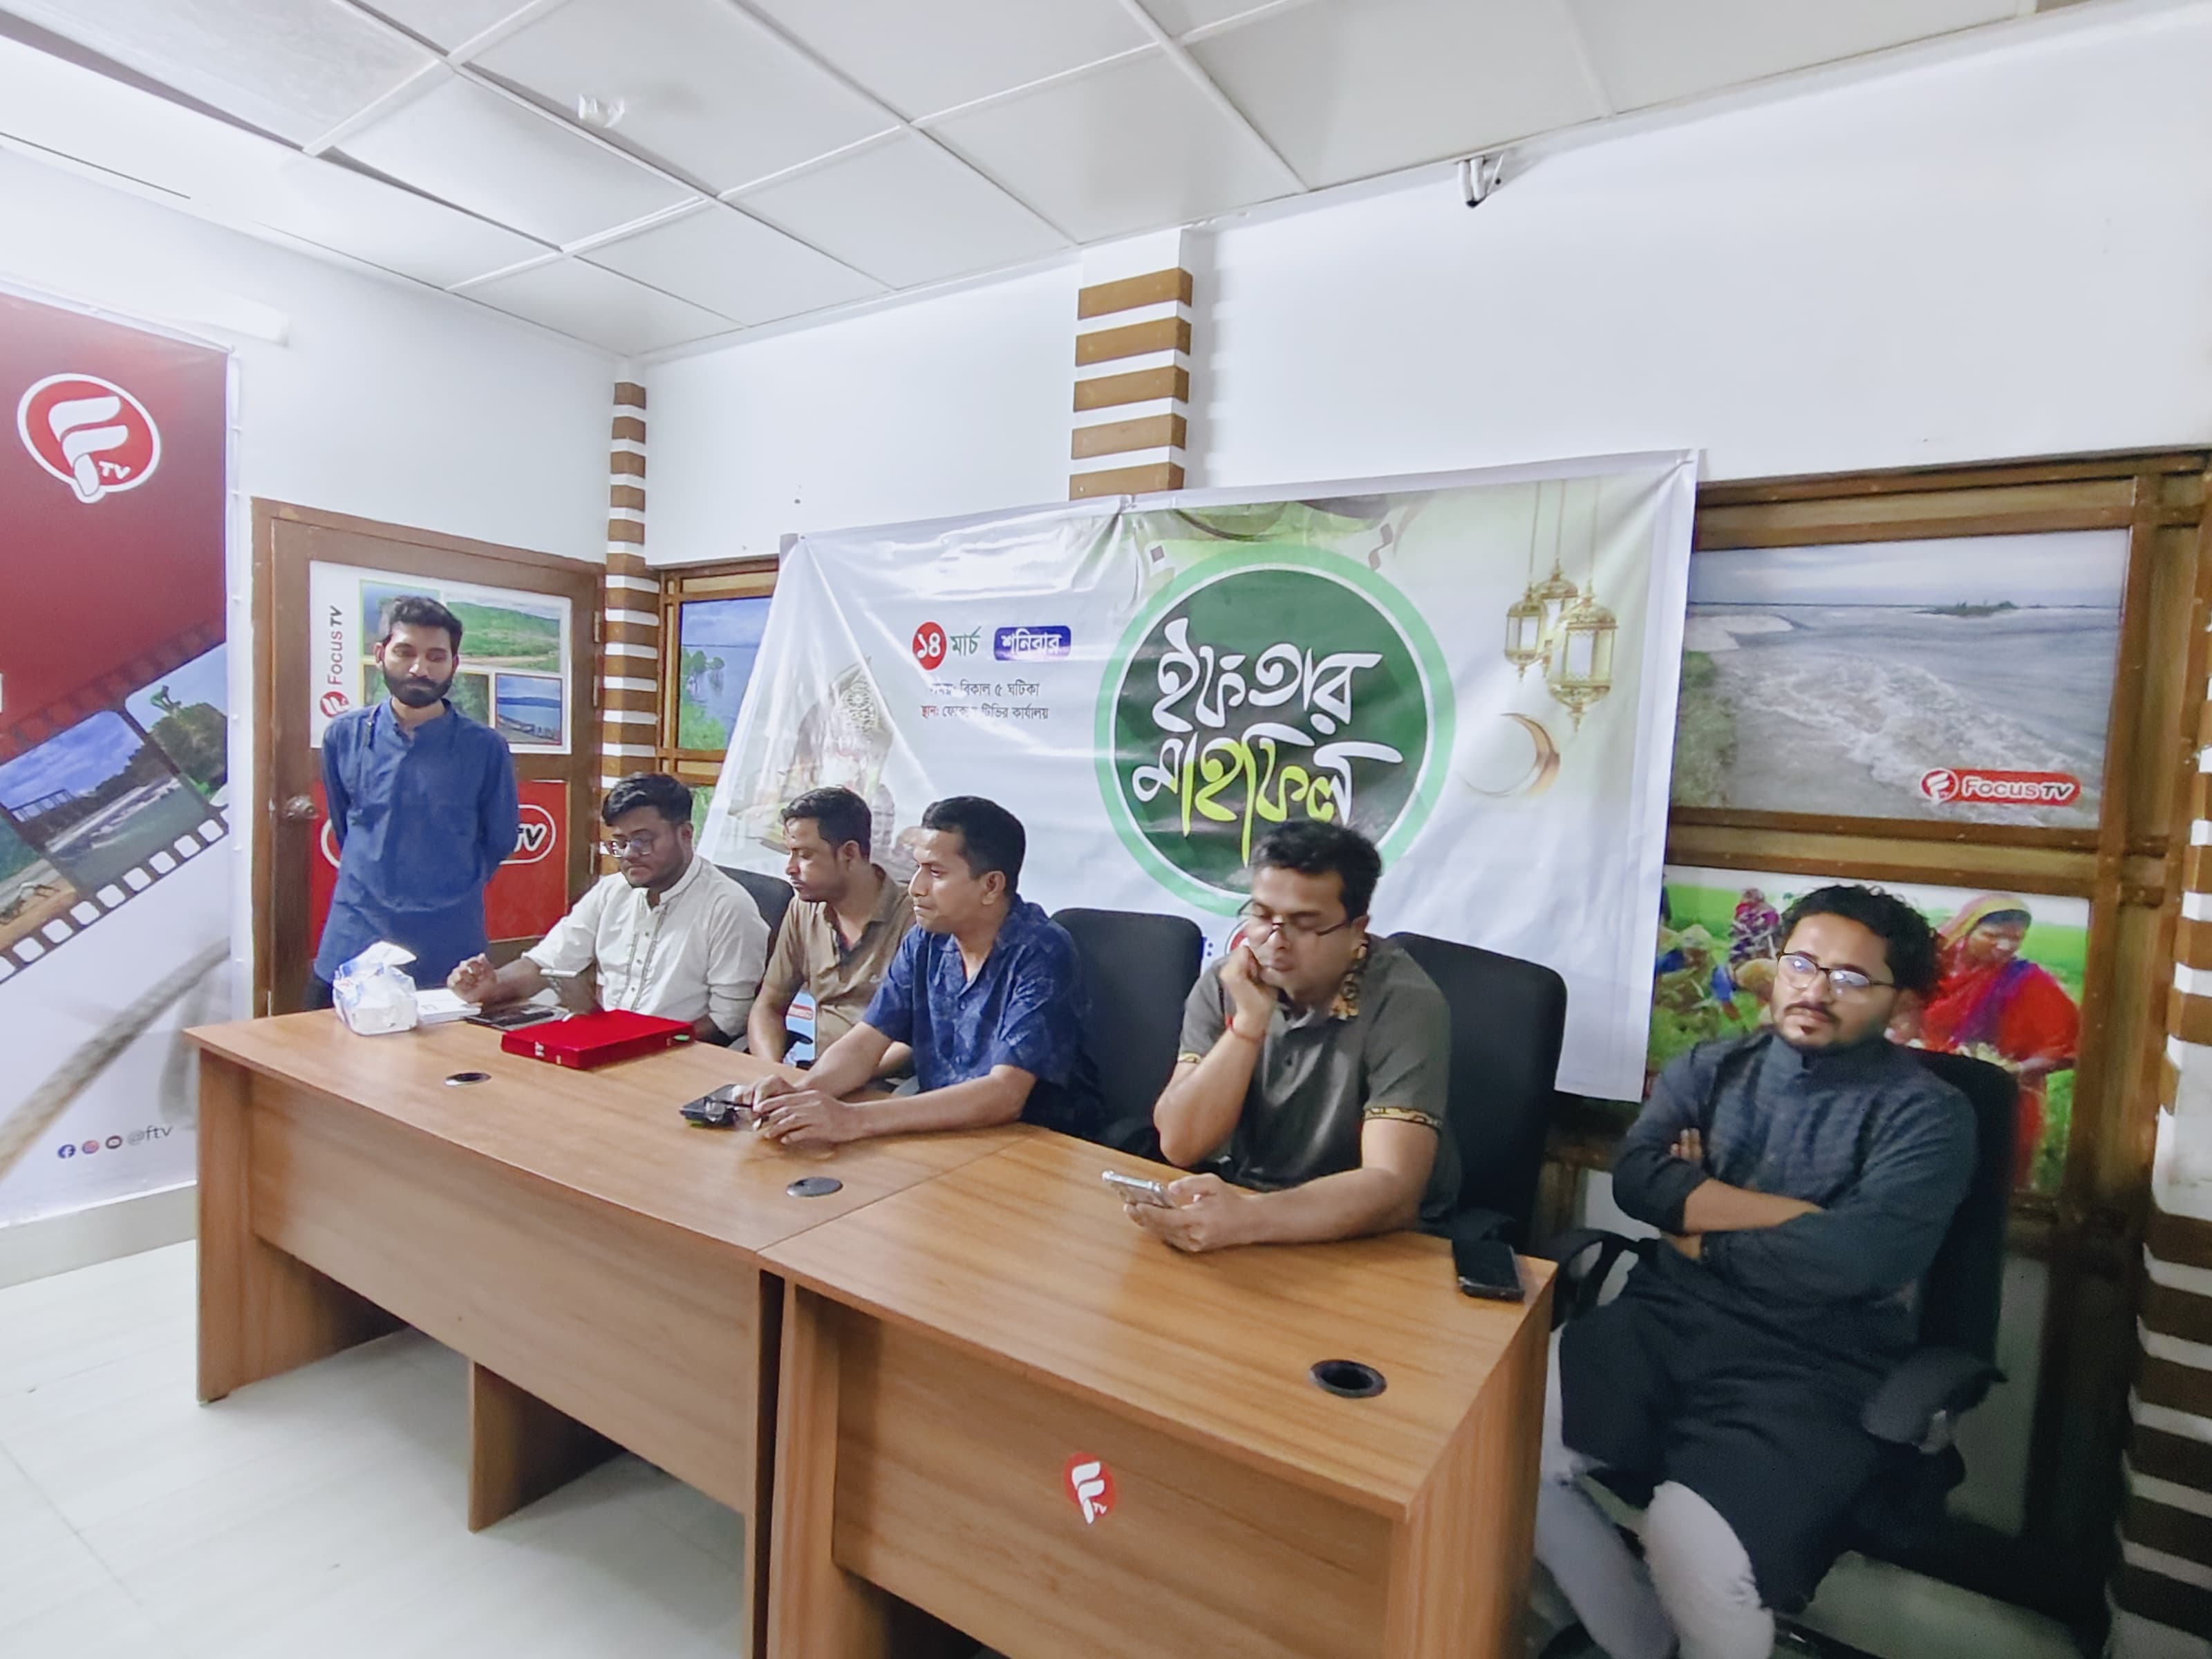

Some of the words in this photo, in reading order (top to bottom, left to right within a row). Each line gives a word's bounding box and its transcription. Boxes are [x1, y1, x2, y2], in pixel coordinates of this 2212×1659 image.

[99, 460, 130, 479] TV
[916, 633, 940, 659] ১৪
[950, 626, 982, 656] মার্চ
[1001, 629, 1062, 654] শনিবার
[960, 679, 991, 696] বিকাল
[995, 684, 1002, 696] ৫
[1008, 679, 1040, 697] ঘটিকা
[1152, 617, 1382, 735] ইফতার
